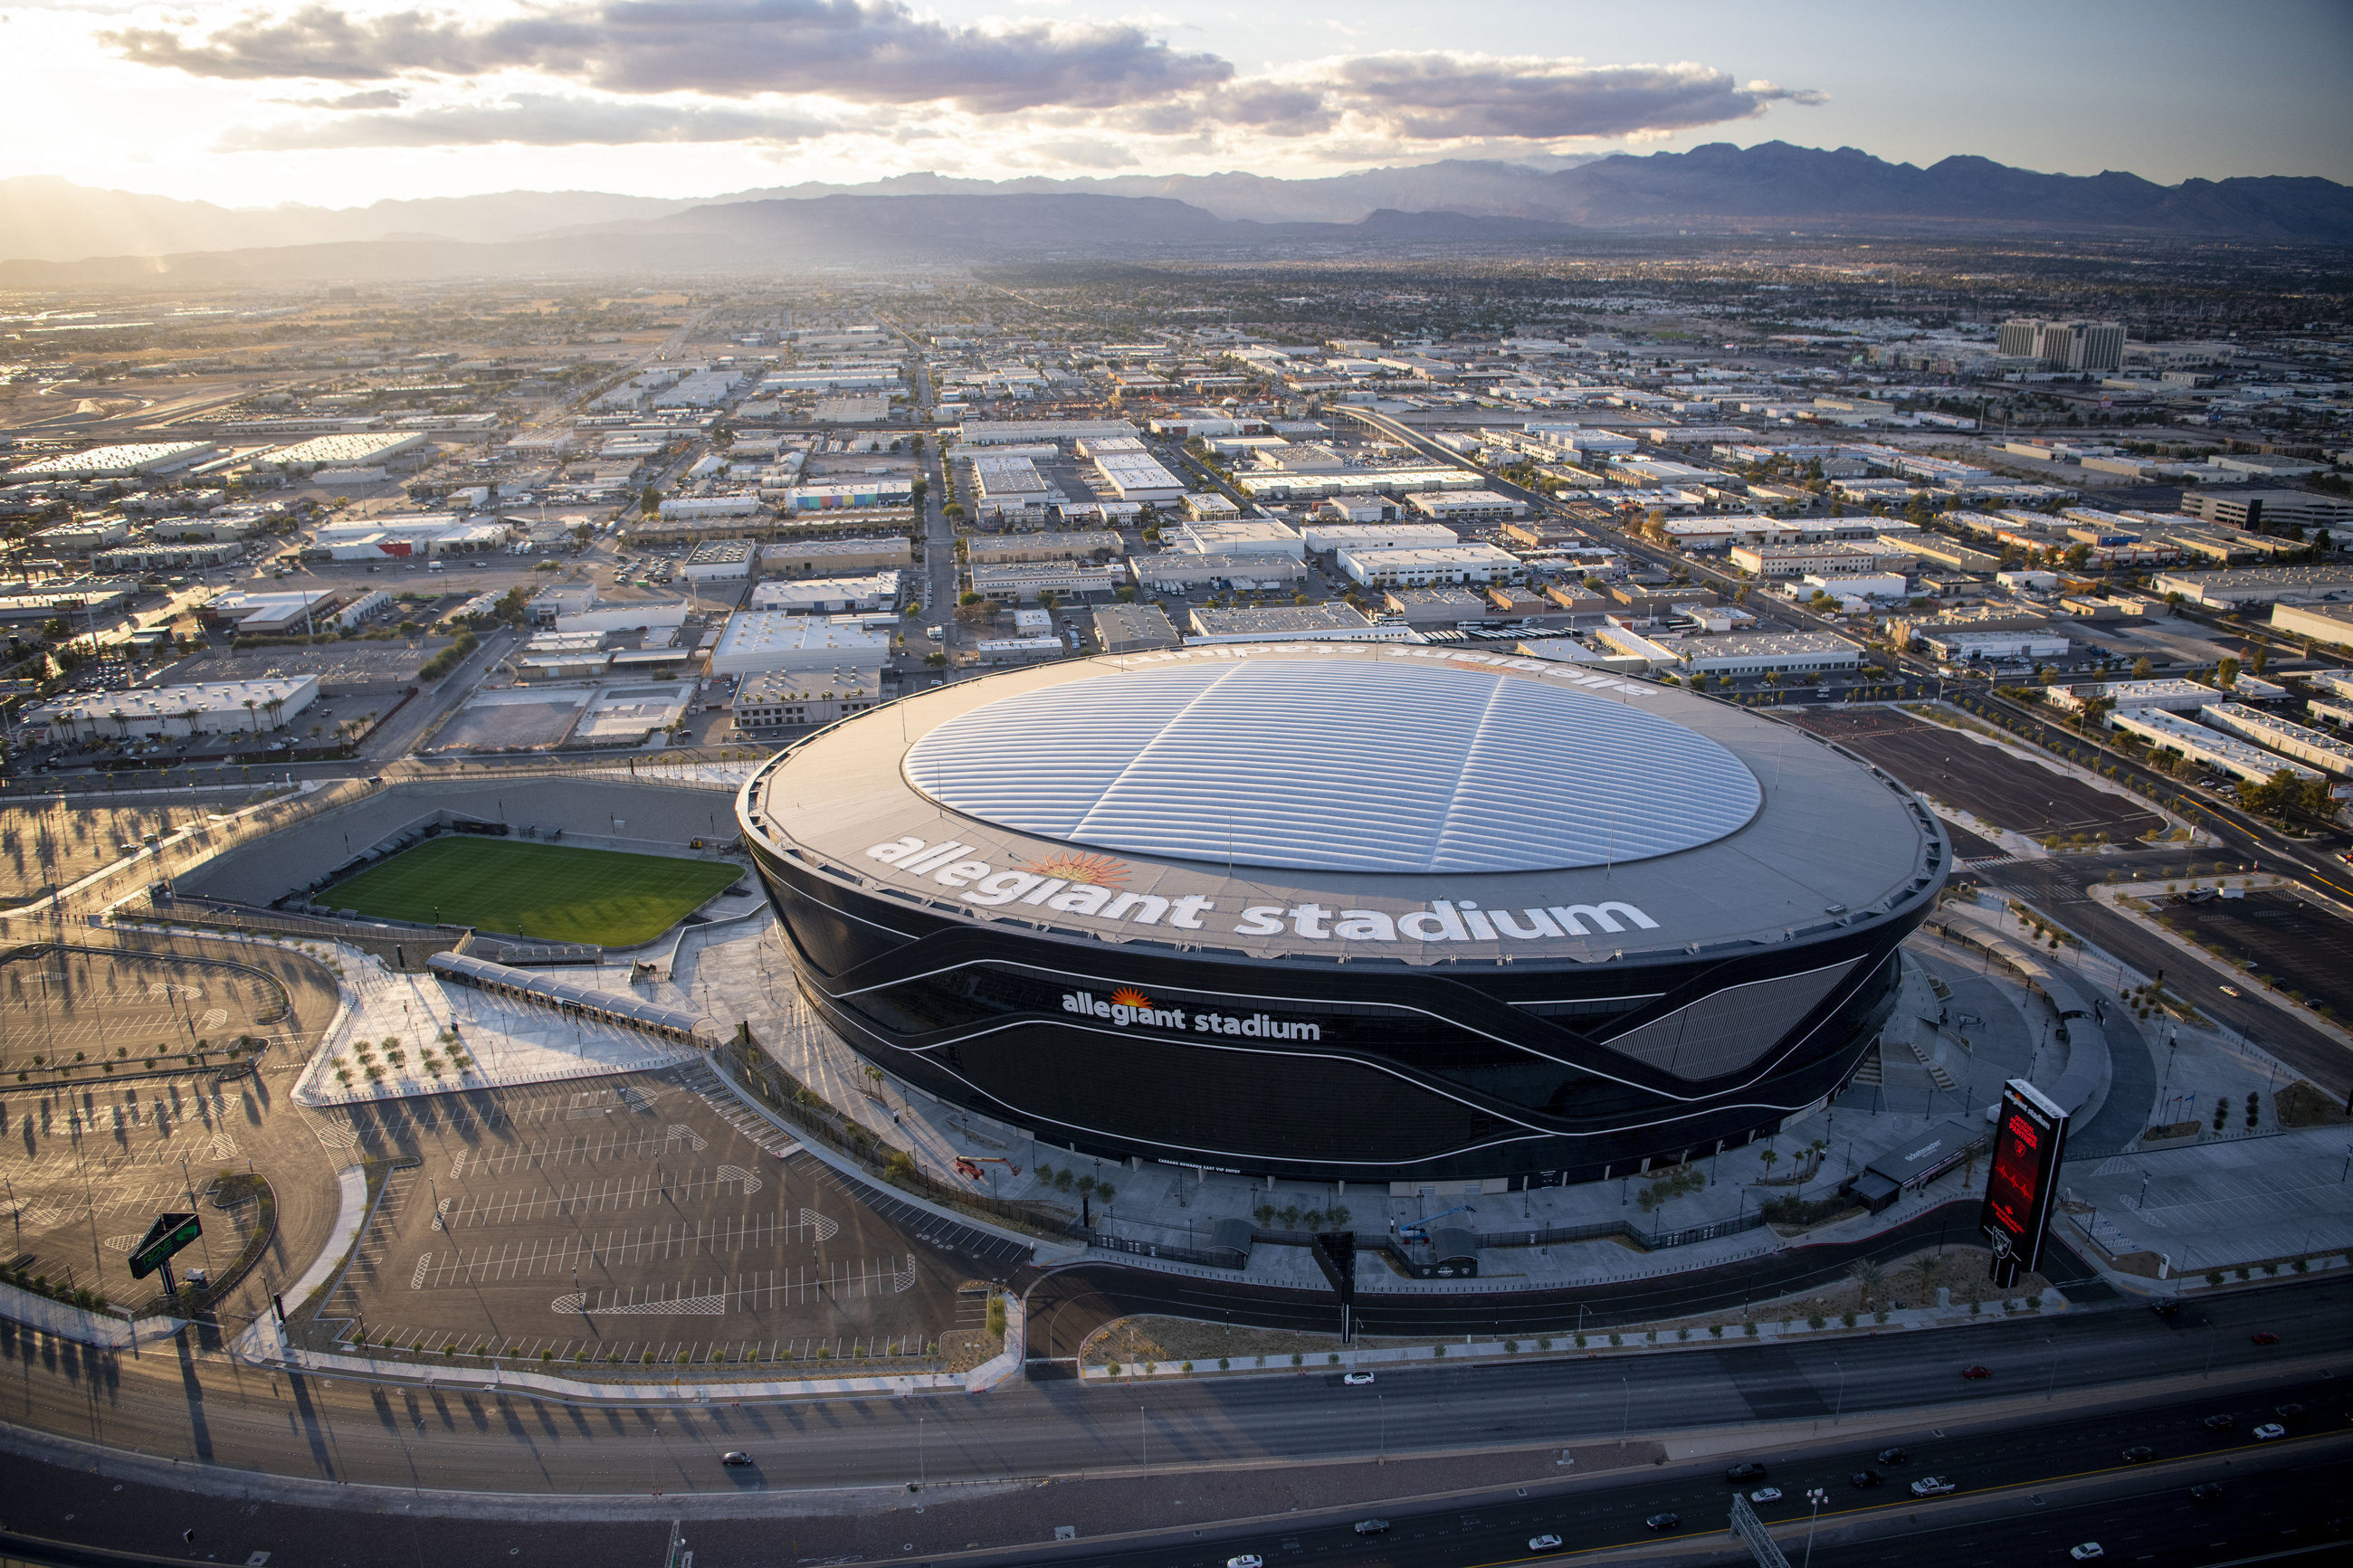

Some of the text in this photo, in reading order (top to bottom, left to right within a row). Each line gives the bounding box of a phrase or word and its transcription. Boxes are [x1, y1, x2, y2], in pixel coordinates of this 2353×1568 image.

[1386, 646, 1659, 695] allegiant
[865, 834, 1661, 942] allegiant stadium
[1062, 991, 1320, 1041] allegiant stadium
[2010, 1117, 2038, 1143] HEALTHCARE
[2015, 1114, 2034, 1134] OFFICIAL
[2026, 1107, 2051, 1130] stadium
[2008, 1121, 2037, 1150] PARTNER
[1904, 1139, 1942, 1162] ticketmaster
[142, 1238, 174, 1266] ROVE
